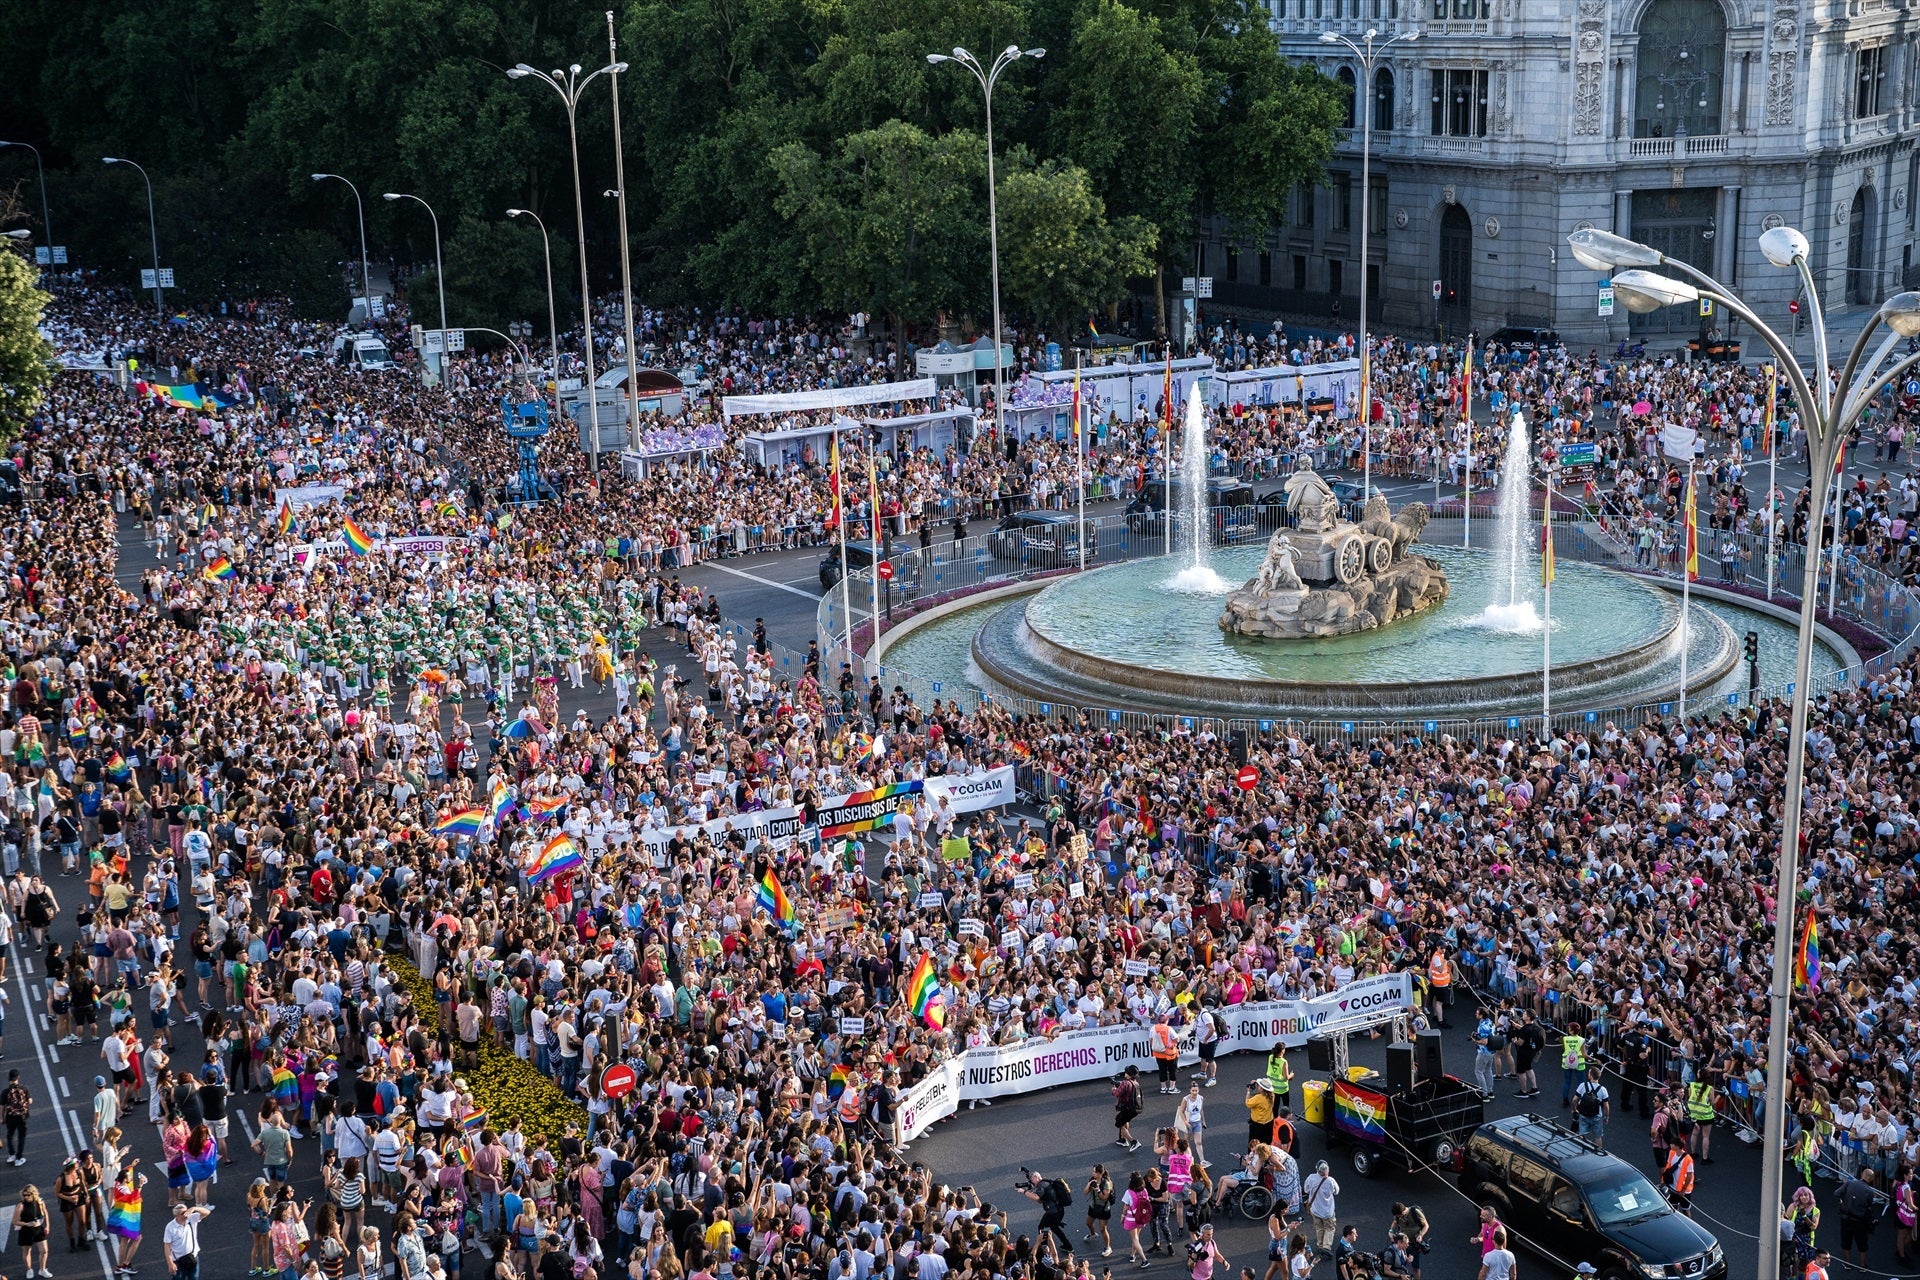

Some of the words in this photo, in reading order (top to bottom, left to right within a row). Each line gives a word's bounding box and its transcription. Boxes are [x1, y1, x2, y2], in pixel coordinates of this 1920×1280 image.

[397, 541, 442, 552] RECHOS
[959, 779, 1002, 795] COGAM
[738, 824, 769, 842] STADO
[771, 818, 801, 837] CONT
[835, 801, 885, 825] DISCURSOS
[886, 799, 898, 813] DE
[1351, 988, 1401, 1010] COGAM
[970, 1060, 1032, 1085] NUESTROS
[1034, 1047, 1100, 1075] DERECHOS.
[1105, 1043, 1128, 1063] POR
[1237, 1020, 1268, 1040] ¡CON
[1271, 1012, 1328, 1036] ORGULLO!
